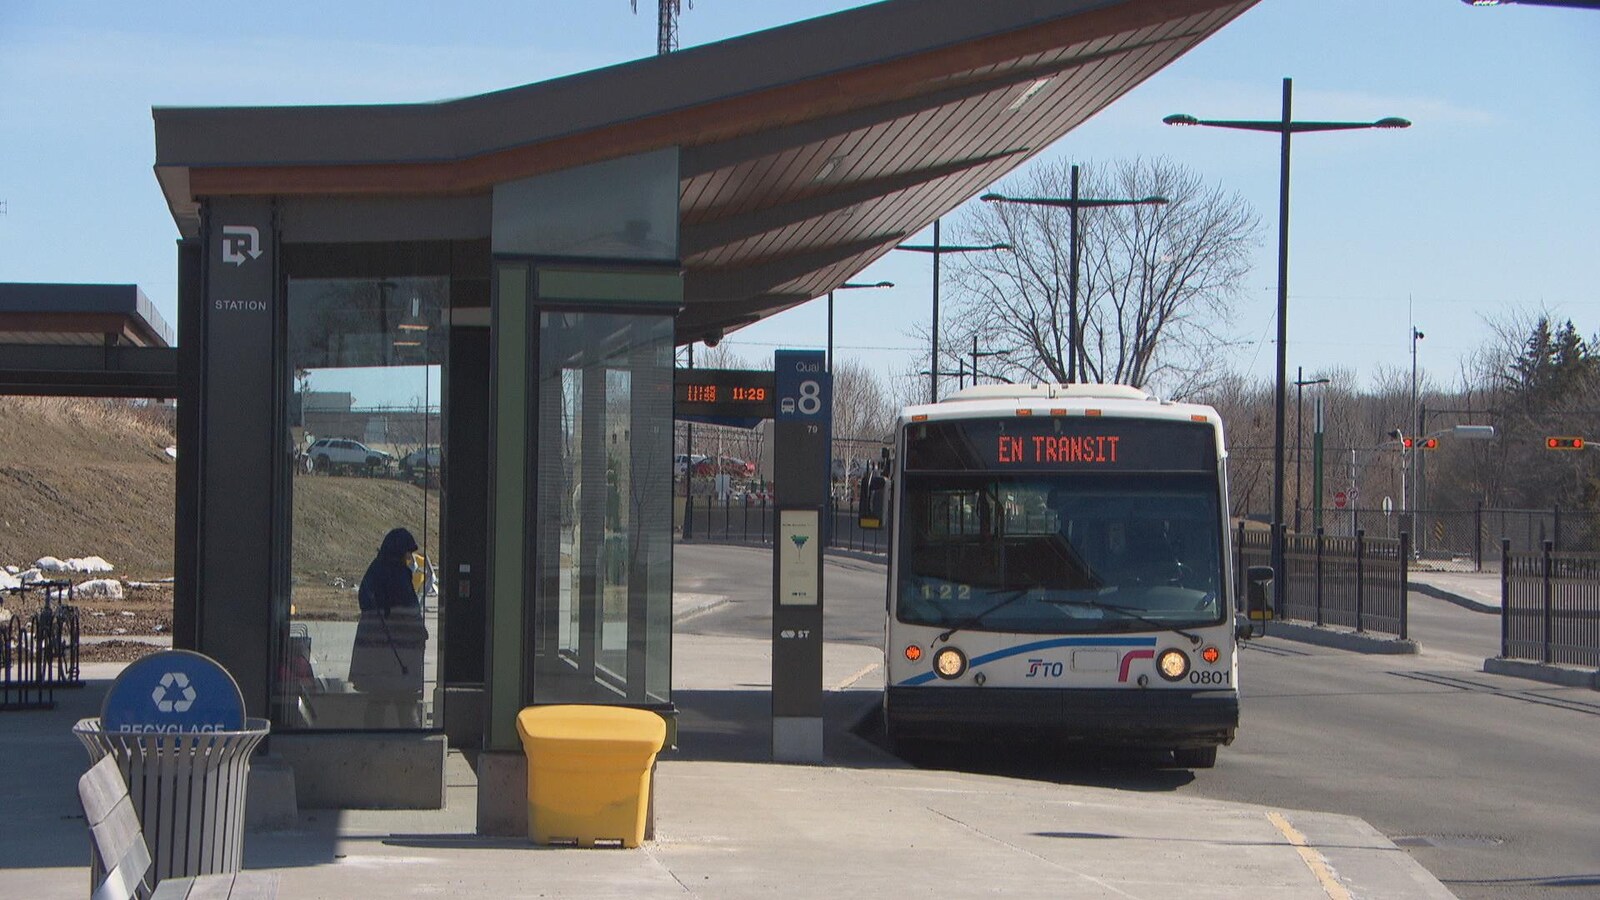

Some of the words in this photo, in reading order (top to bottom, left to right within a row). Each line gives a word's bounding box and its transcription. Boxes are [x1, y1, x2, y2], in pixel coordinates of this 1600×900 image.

[215, 300, 267, 311] STATION
[732, 386, 765, 401] 11:29
[798, 380, 821, 415] 8
[998, 435, 1023, 462] EN
[1032, 435, 1120, 462] TRANSIT
[921, 583, 972, 601] 122
[1025, 658, 1064, 678] STO
[1189, 670, 1230, 685] 0801
